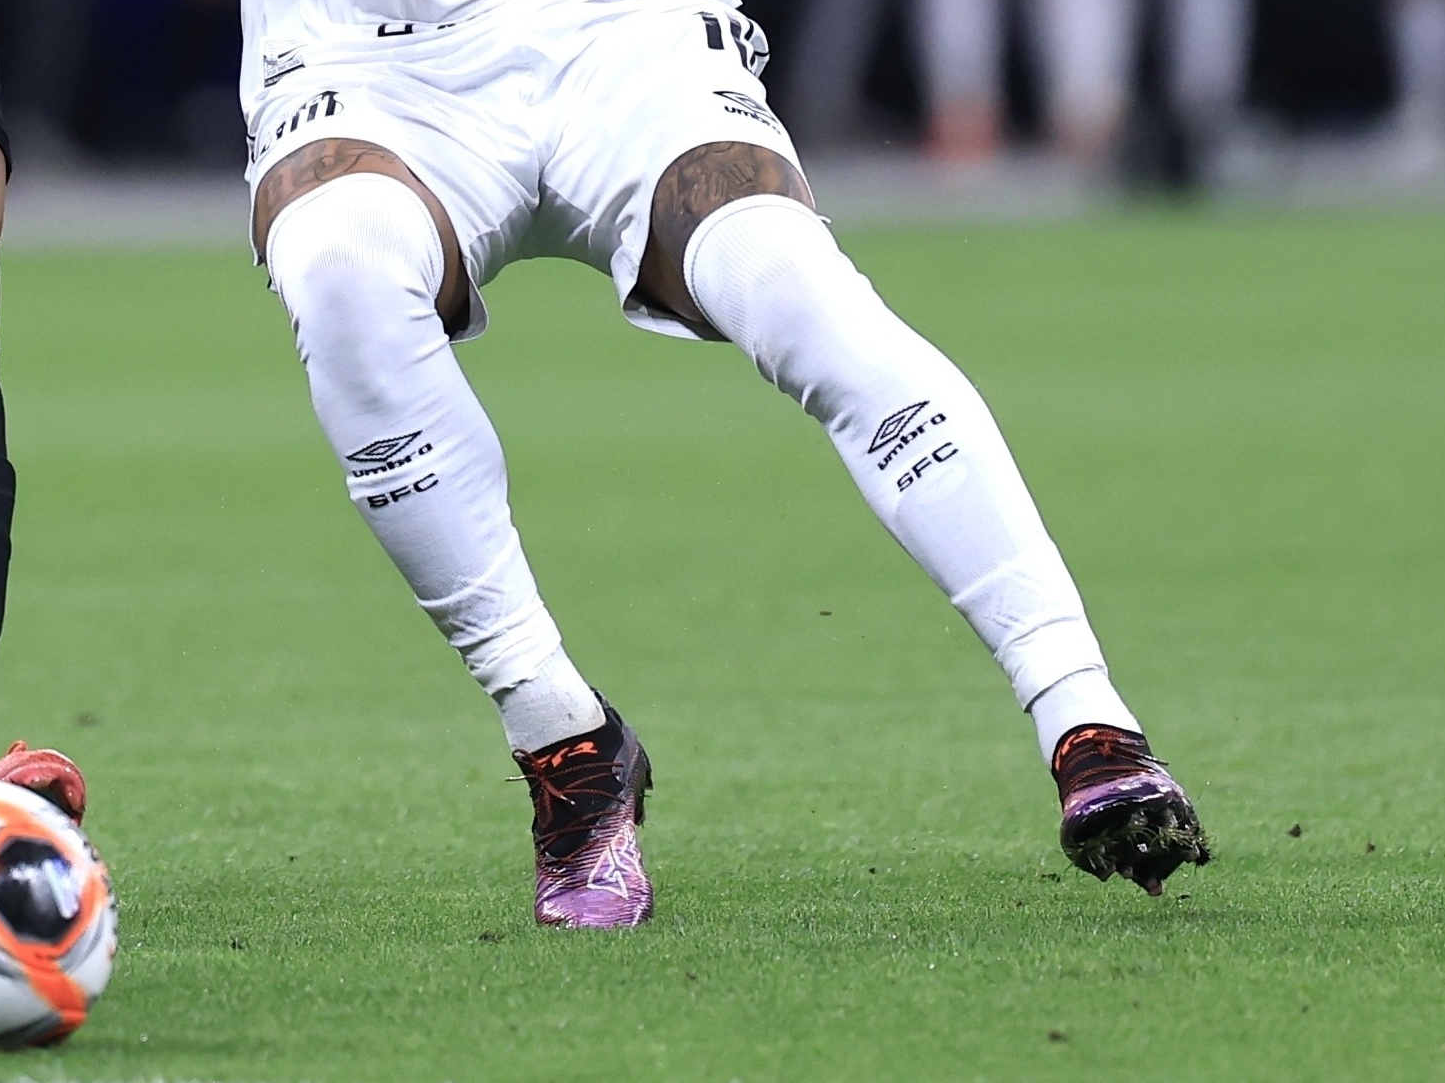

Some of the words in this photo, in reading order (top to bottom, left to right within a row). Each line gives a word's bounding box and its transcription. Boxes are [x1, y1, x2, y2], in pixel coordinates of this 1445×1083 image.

[352, 443, 433, 477] umbro
[877, 413, 947, 470] umbro
[897, 442, 959, 492] SFC
[367, 473, 439, 508] SFC
